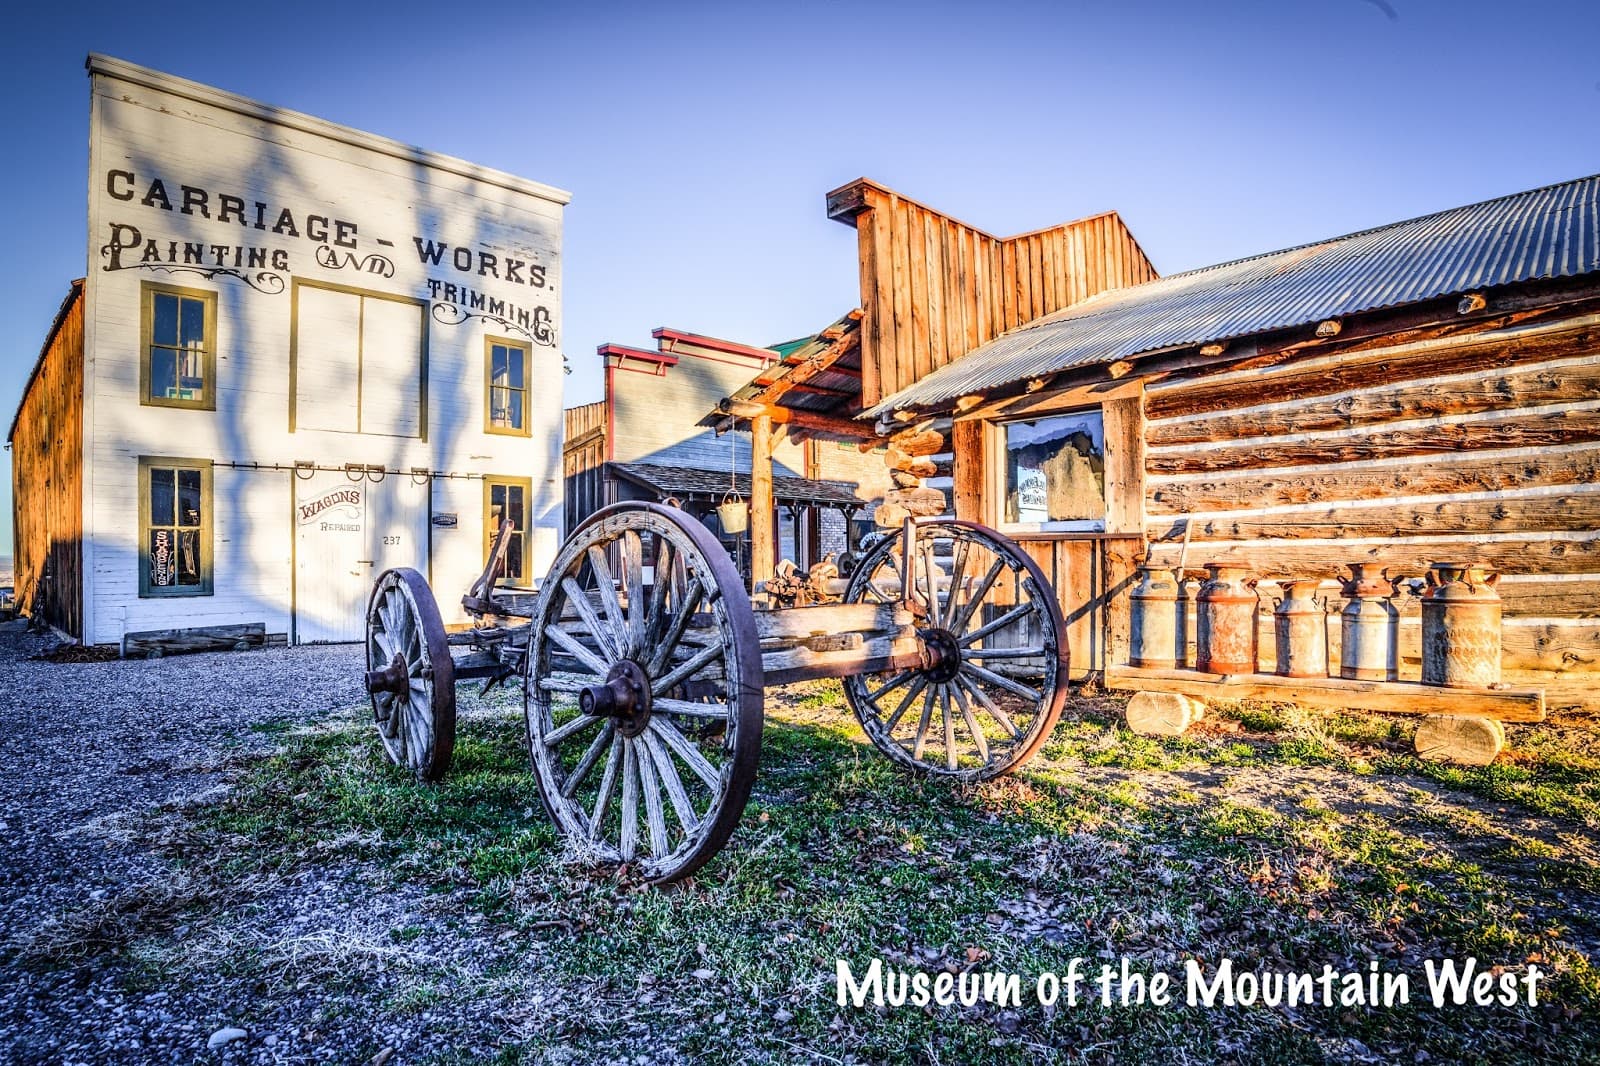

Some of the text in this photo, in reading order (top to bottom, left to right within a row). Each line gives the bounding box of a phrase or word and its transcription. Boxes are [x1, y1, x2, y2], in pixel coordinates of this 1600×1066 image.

[107, 170, 358, 248] CARRIAGE
[412, 237, 556, 292] WORKS.
[101, 222, 290, 276] PAINTING
[315, 244, 396, 279] AND
[299, 490, 360, 519] WAGONS
[320, 522, 360, 532] REPAIRED
[383, 536, 401, 546] 237
